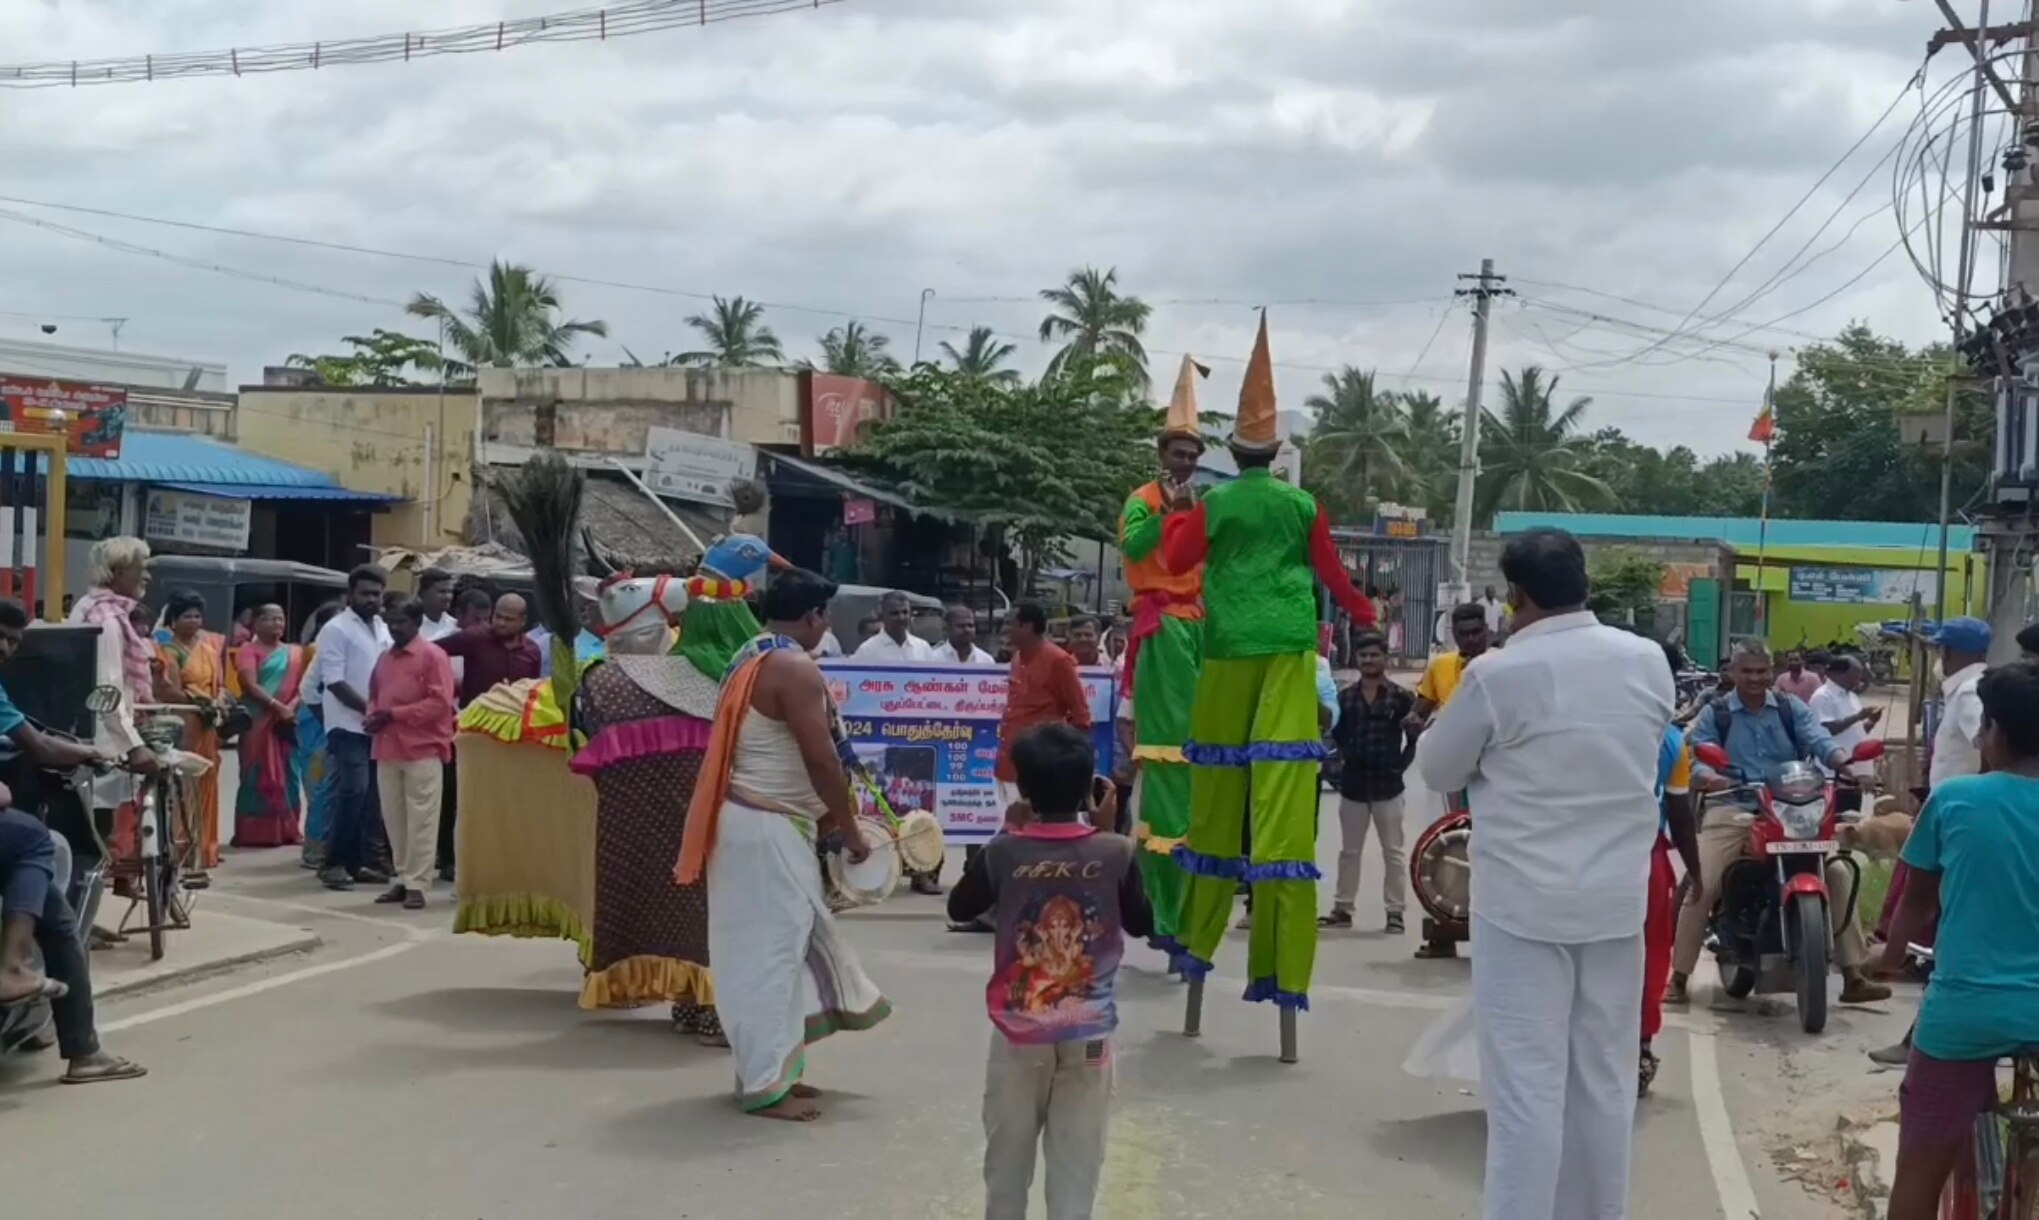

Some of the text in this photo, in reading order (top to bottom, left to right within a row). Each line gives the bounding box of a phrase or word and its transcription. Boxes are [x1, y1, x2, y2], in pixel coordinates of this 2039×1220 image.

[858, 679, 894, 693] அரசு
[904, 678, 969, 695] ஆண்கள்
[881, 720, 973, 741] பொதுத்தேர்வு
[948, 742, 968, 750] 100
[947, 753, 968, 762] 100
[949, 813, 974, 823] SMC
